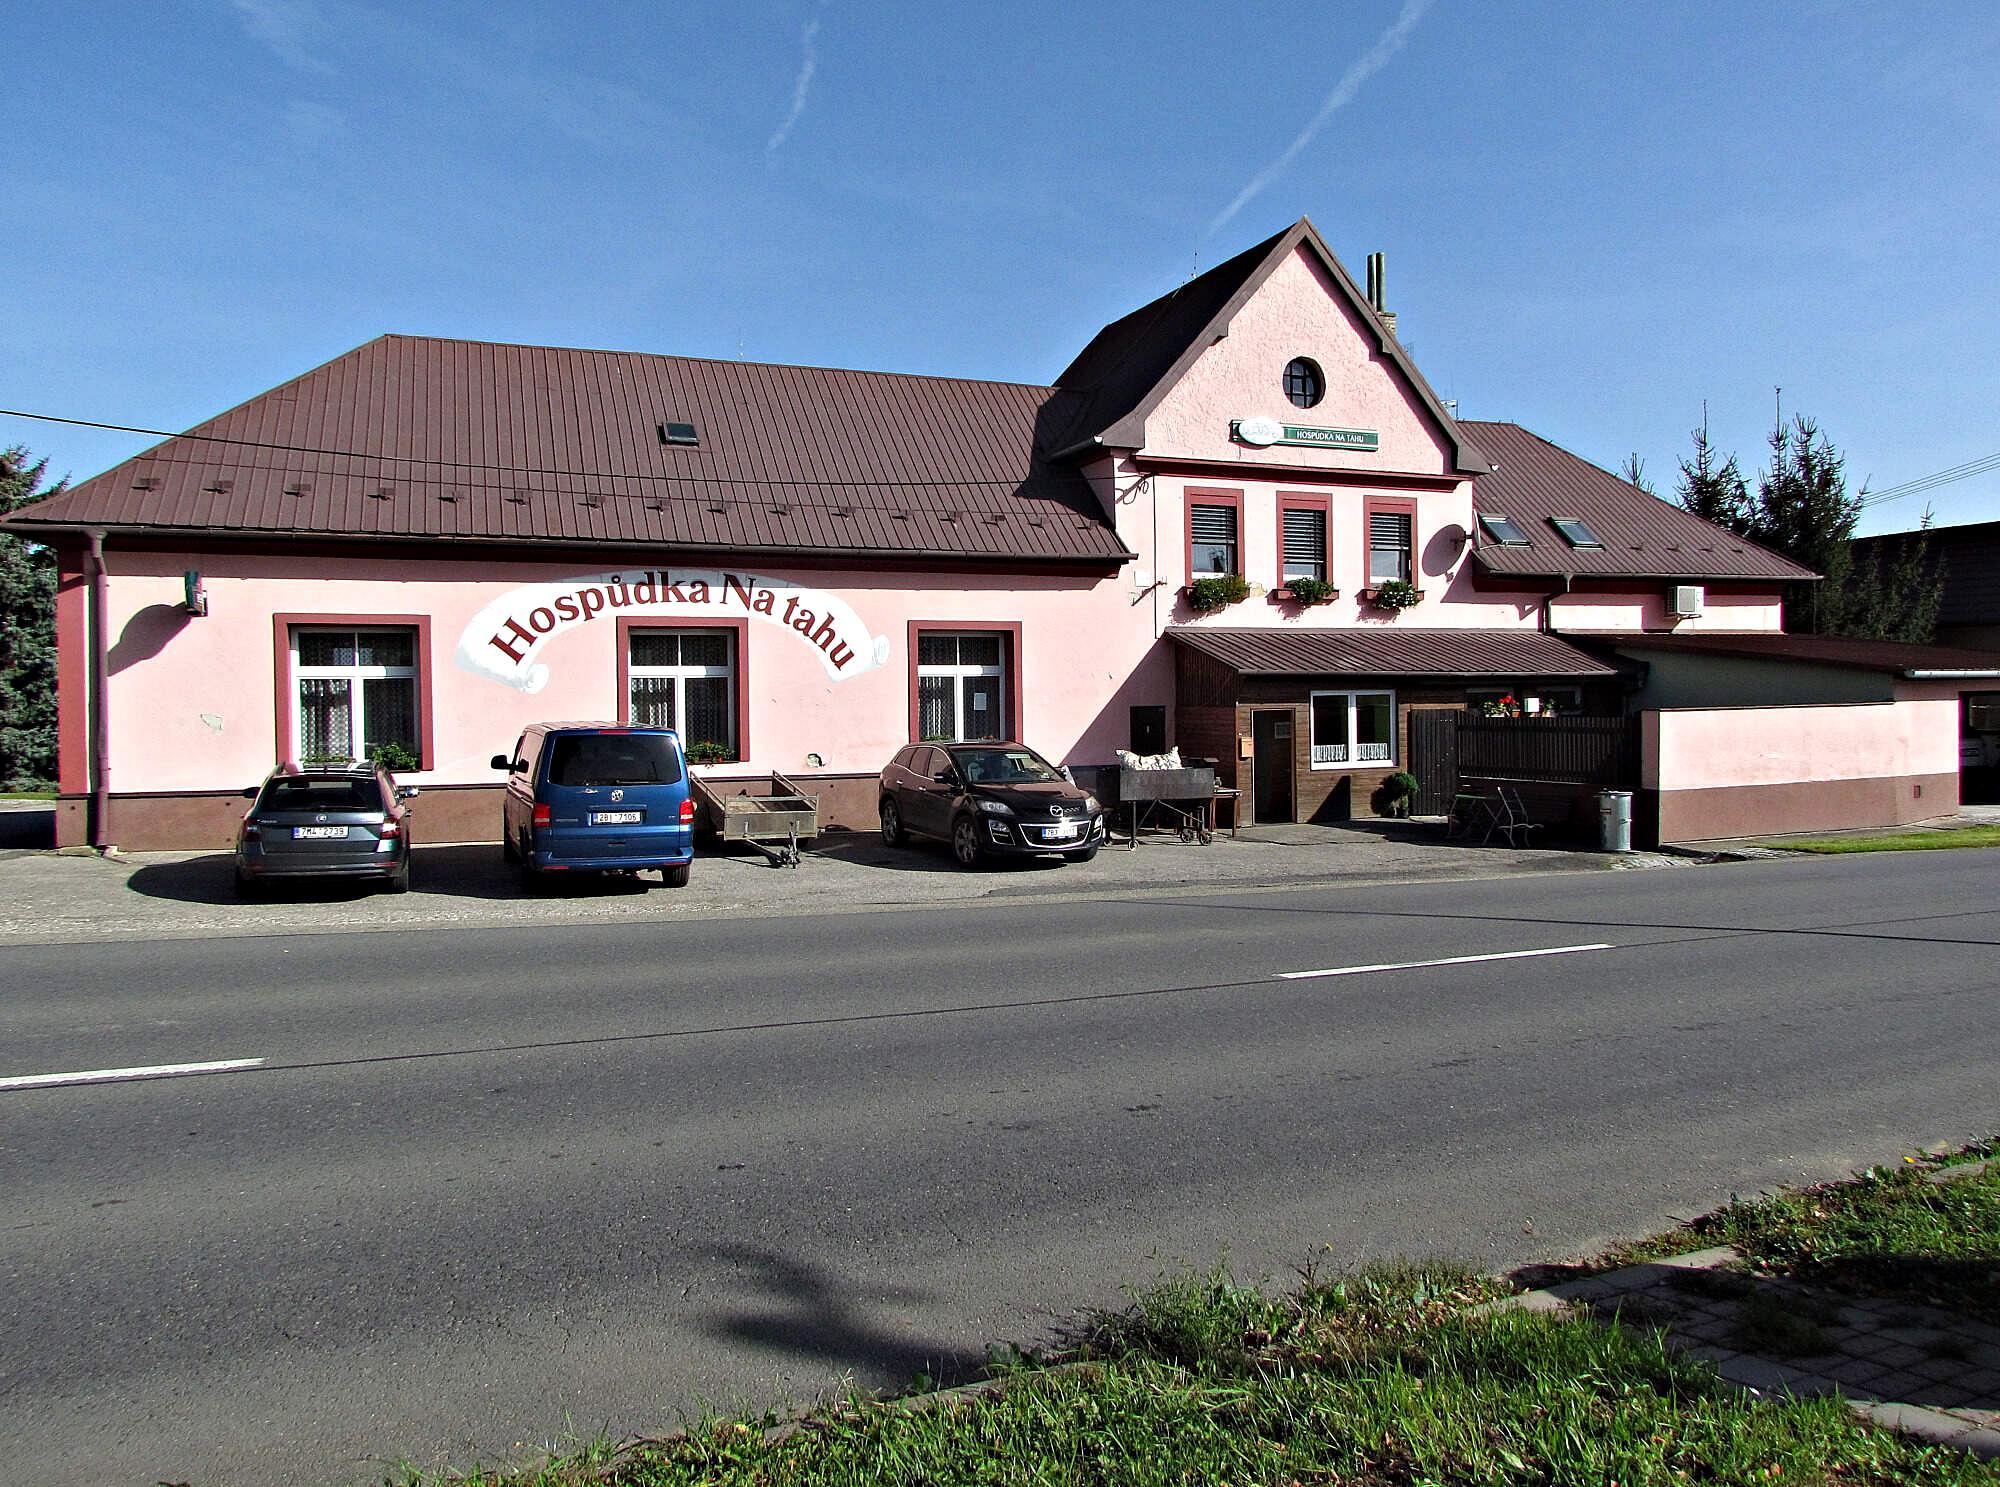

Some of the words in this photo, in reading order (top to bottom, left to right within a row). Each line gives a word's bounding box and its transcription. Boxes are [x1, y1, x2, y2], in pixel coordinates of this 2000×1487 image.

[1335, 433, 1345, 442] NA
[1346, 434, 1364, 443] TAHU
[488, 571, 711, 665] Hospůdka
[720, 573, 776, 616] Na
[782, 595, 856, 671] tahu
[323, 827, 344, 835] 2739
